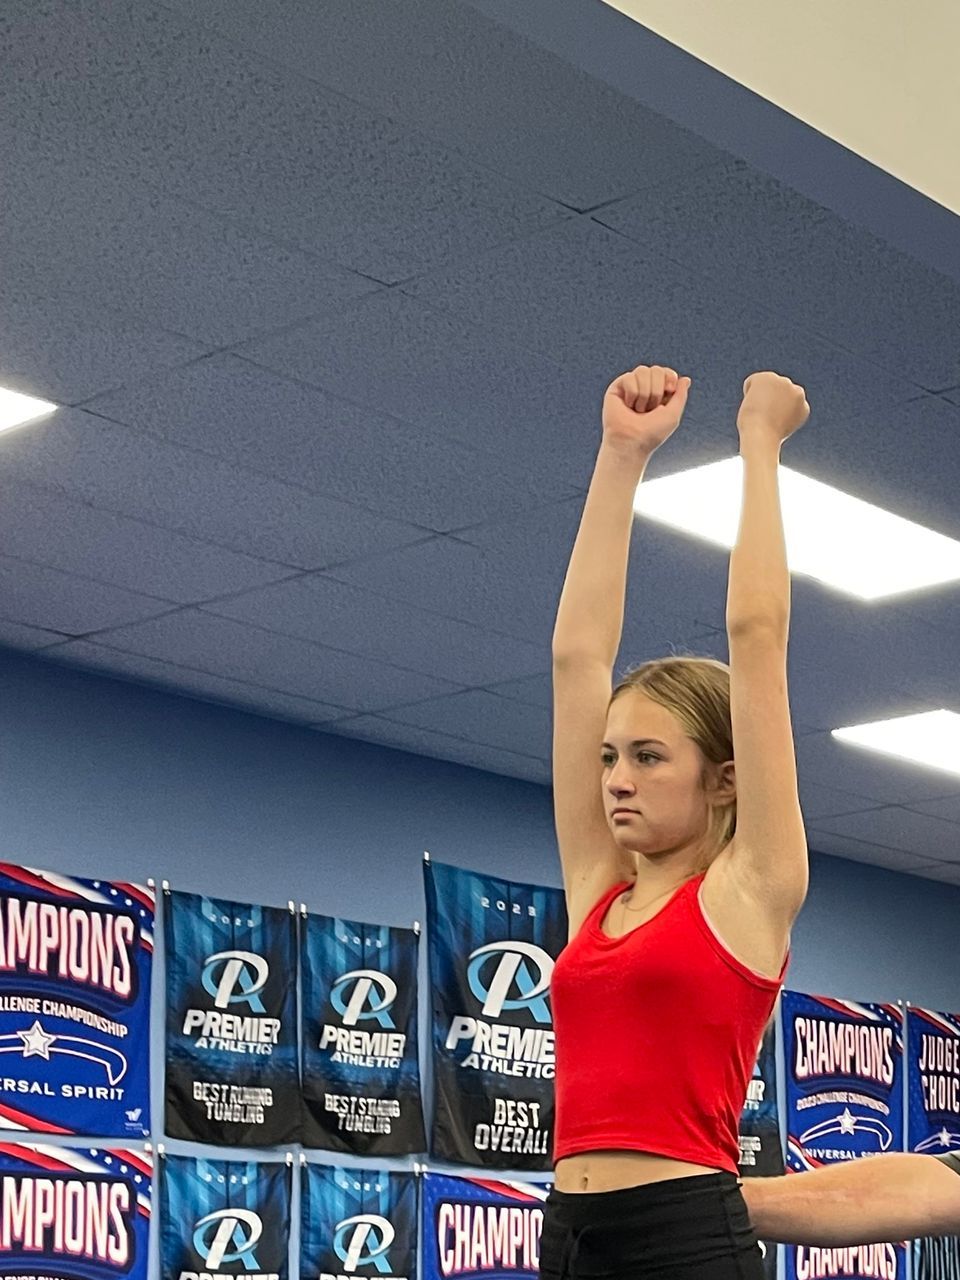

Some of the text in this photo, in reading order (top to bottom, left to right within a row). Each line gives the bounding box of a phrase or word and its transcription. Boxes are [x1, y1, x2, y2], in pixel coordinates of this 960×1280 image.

[481, 896, 537, 917] 2023
[42, 999, 129, 1038] CHAMPIONSHIP
[183, 1009, 281, 1044] PREMIER
[194, 1036, 273, 1055] ATHLETICS
[445, 1016, 556, 1064] PREMIE
[795, 1017, 894, 1086] CHAMPIONS
[460, 1053, 556, 1079] ATHLETIC
[0, 1077, 125, 1101] RSAL SPIRIT
[193, 1081, 229, 1103] BEST
[324, 1093, 357, 1114] BEST
[493, 1098, 540, 1128] BEST
[474, 1123, 548, 1154] OVERALL
[802, 1148, 857, 1160] NIVERSAL
[439, 1203, 544, 1277] CHAMPIO
